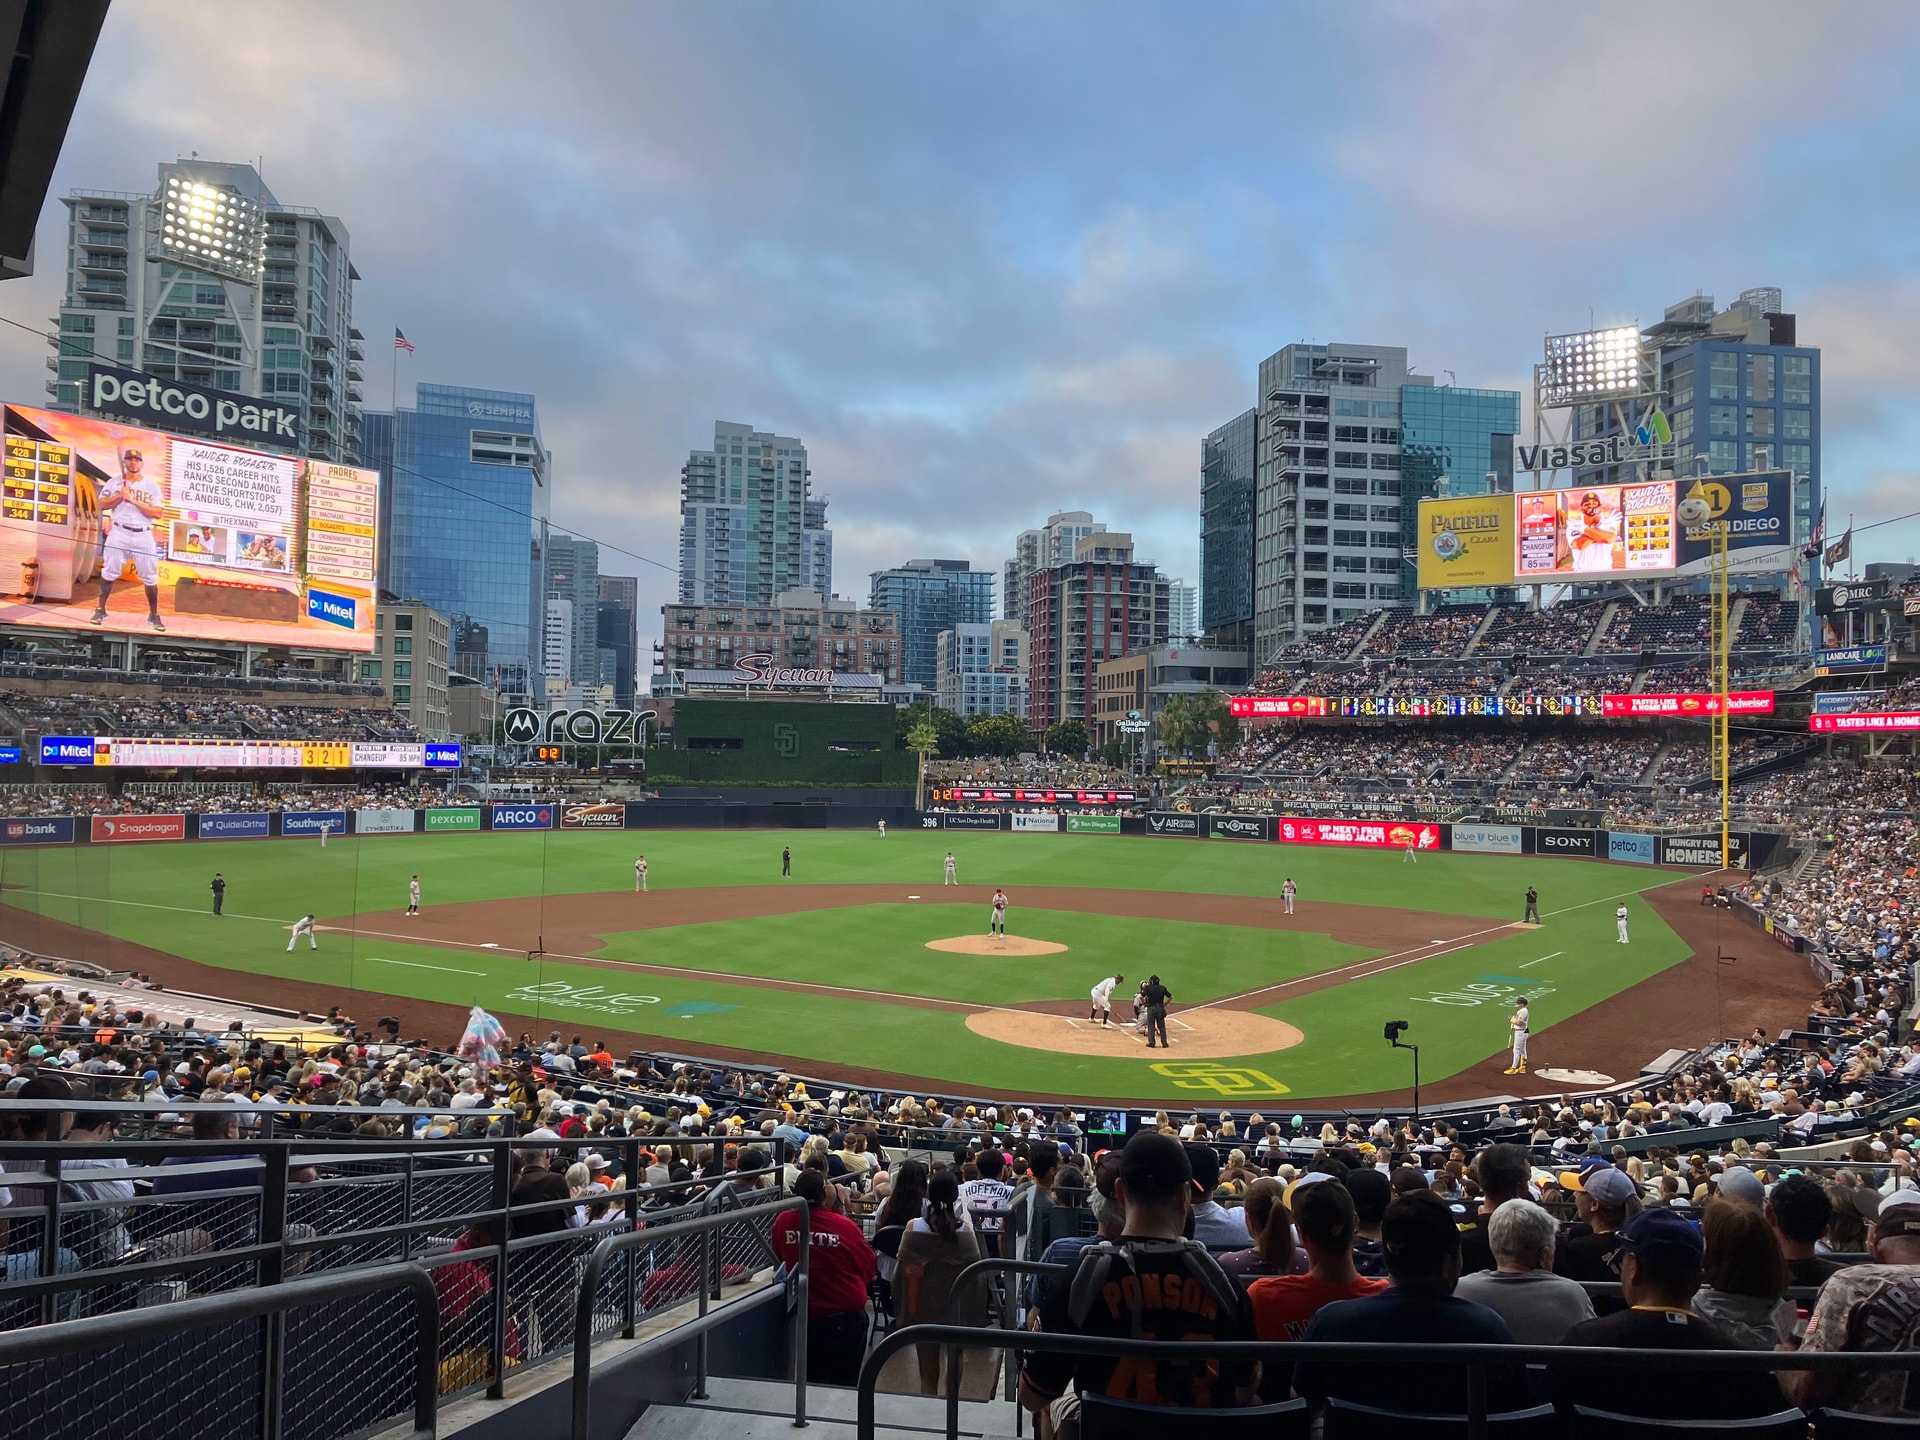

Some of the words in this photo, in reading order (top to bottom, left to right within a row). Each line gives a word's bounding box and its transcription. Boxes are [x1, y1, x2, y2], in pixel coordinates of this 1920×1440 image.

[93, 373, 209, 419] petco
[216, 400, 296, 437] park
[485, 407, 530, 418] SEMPRA
[12, 447, 30, 458] 428
[48, 453, 61, 463] 116
[1518, 437, 1624, 470] Viasat
[192, 449, 229, 464] XANDER
[232, 456, 277, 471] BOGAERTS
[14, 468, 26, 478] 53
[187, 460, 201, 471] HIS
[203, 463, 225, 475] 1,526
[227, 468, 259, 480] CAREER
[261, 473, 280, 484] HITS
[328, 466, 358, 481] PADRES
[49, 473, 59, 483] 12
[184, 471, 213, 483] RANKS
[215, 476, 249, 489] SECOND
[251, 482, 281, 494] AMONG
[14, 489, 25, 498] 19
[189, 482, 222, 494] ACTIVE
[221, 487, 276, 503] SHORTSTOPS
[1629, 484, 1667, 499] XANDER
[47, 494, 59, 503] 40
[181, 490, 193, 501] (E.
[195, 493, 233, 508] ANDRUS,
[235, 499, 256, 511] CHW,
[258, 504, 282, 516] 2,057)
[1626, 493, 1673, 511] BOGAERTS
[8, 509, 29, 519] .344
[43, 513, 62, 523] .744
[320, 511, 344, 520] MACHADO
[212, 516, 259, 528] @THEXMAN2
[320, 522, 345, 531] BOGAERTS
[1431, 514, 1499, 534] PACIFICO
[1733, 517, 1780, 532] DIEGO
[1470, 536, 1498, 544] CLARA
[318, 555, 338, 563] COOPER
[1528, 560, 1538, 568] 85
[1849, 587, 1873, 599] MRC
[323, 601, 353, 620] Mitel
[1826, 651, 1861, 662] LANDCARE
[1862, 649, 1885, 658] LOGIC
[733, 653, 836, 691] Sycuan
[1331, 702, 1336, 711] F
[1725, 697, 1770, 708] Budweiser
[544, 709, 658, 745] razr
[1836, 718, 1865, 727] TASTES
[1866, 717, 1885, 727] LIKE
[1886, 717, 1893, 726] A
[1894, 716, 1920, 726] HOME
[1120, 726, 1146, 734] Square
[773, 722, 799, 758] SD
[60, 745, 92, 757] Mitel
[437, 751, 459, 761] Mitel
[539, 748, 559, 759] 0:12
[307, 750, 314, 764] 3
[322, 750, 329, 764] 2
[339, 750, 343, 764] 1
[354, 753, 387, 762] CHANGEUP
[933, 789, 950, 800] 0:12
[1230, 799, 1272, 807] TEMPLETON
[1311, 802, 1337, 810] WHISKEY
[1413, 805, 1463, 815] TEMPLETON
[1495, 808, 1547, 818] TEMPLETON
[495, 811, 536, 823] ARCO
[565, 807, 618, 826] Sycuan
[216, 820, 266, 830] QuidelOrtho
[286, 818, 335, 828] Southwest
[922, 817, 938, 828] 396
[1166, 819, 1180, 827] AIR
[1217, 820, 1260, 832] EVOTEK
[8, 826, 23, 835] us
[25, 823, 57, 835] bank
[119, 823, 179, 834] Snapdragon
[1333, 825, 1360, 834] NEXT:
[1361, 826, 1385, 835] FREE
[1320, 833, 1353, 841] JUMBO
[1454, 831, 1475, 841] blue
[1488, 833, 1509, 842] blue
[1545, 837, 1591, 848] SONY
[1611, 840, 1637, 853] petco
[1669, 838, 1701, 847] HUNGRY
[1702, 839, 1718, 848] FOR
[1665, 848, 1722, 865] HOMERS
[513, 981, 661, 1006] blue
[1410, 983, 1515, 1007] blue
[505, 993, 636, 1014] california
[1149, 1063, 1291, 1095] SD
[966, 1183, 1011, 1200] HOFFMAN
[785, 1230, 840, 1248] EITE
[1102, 1273, 1218, 1321] PONSON
